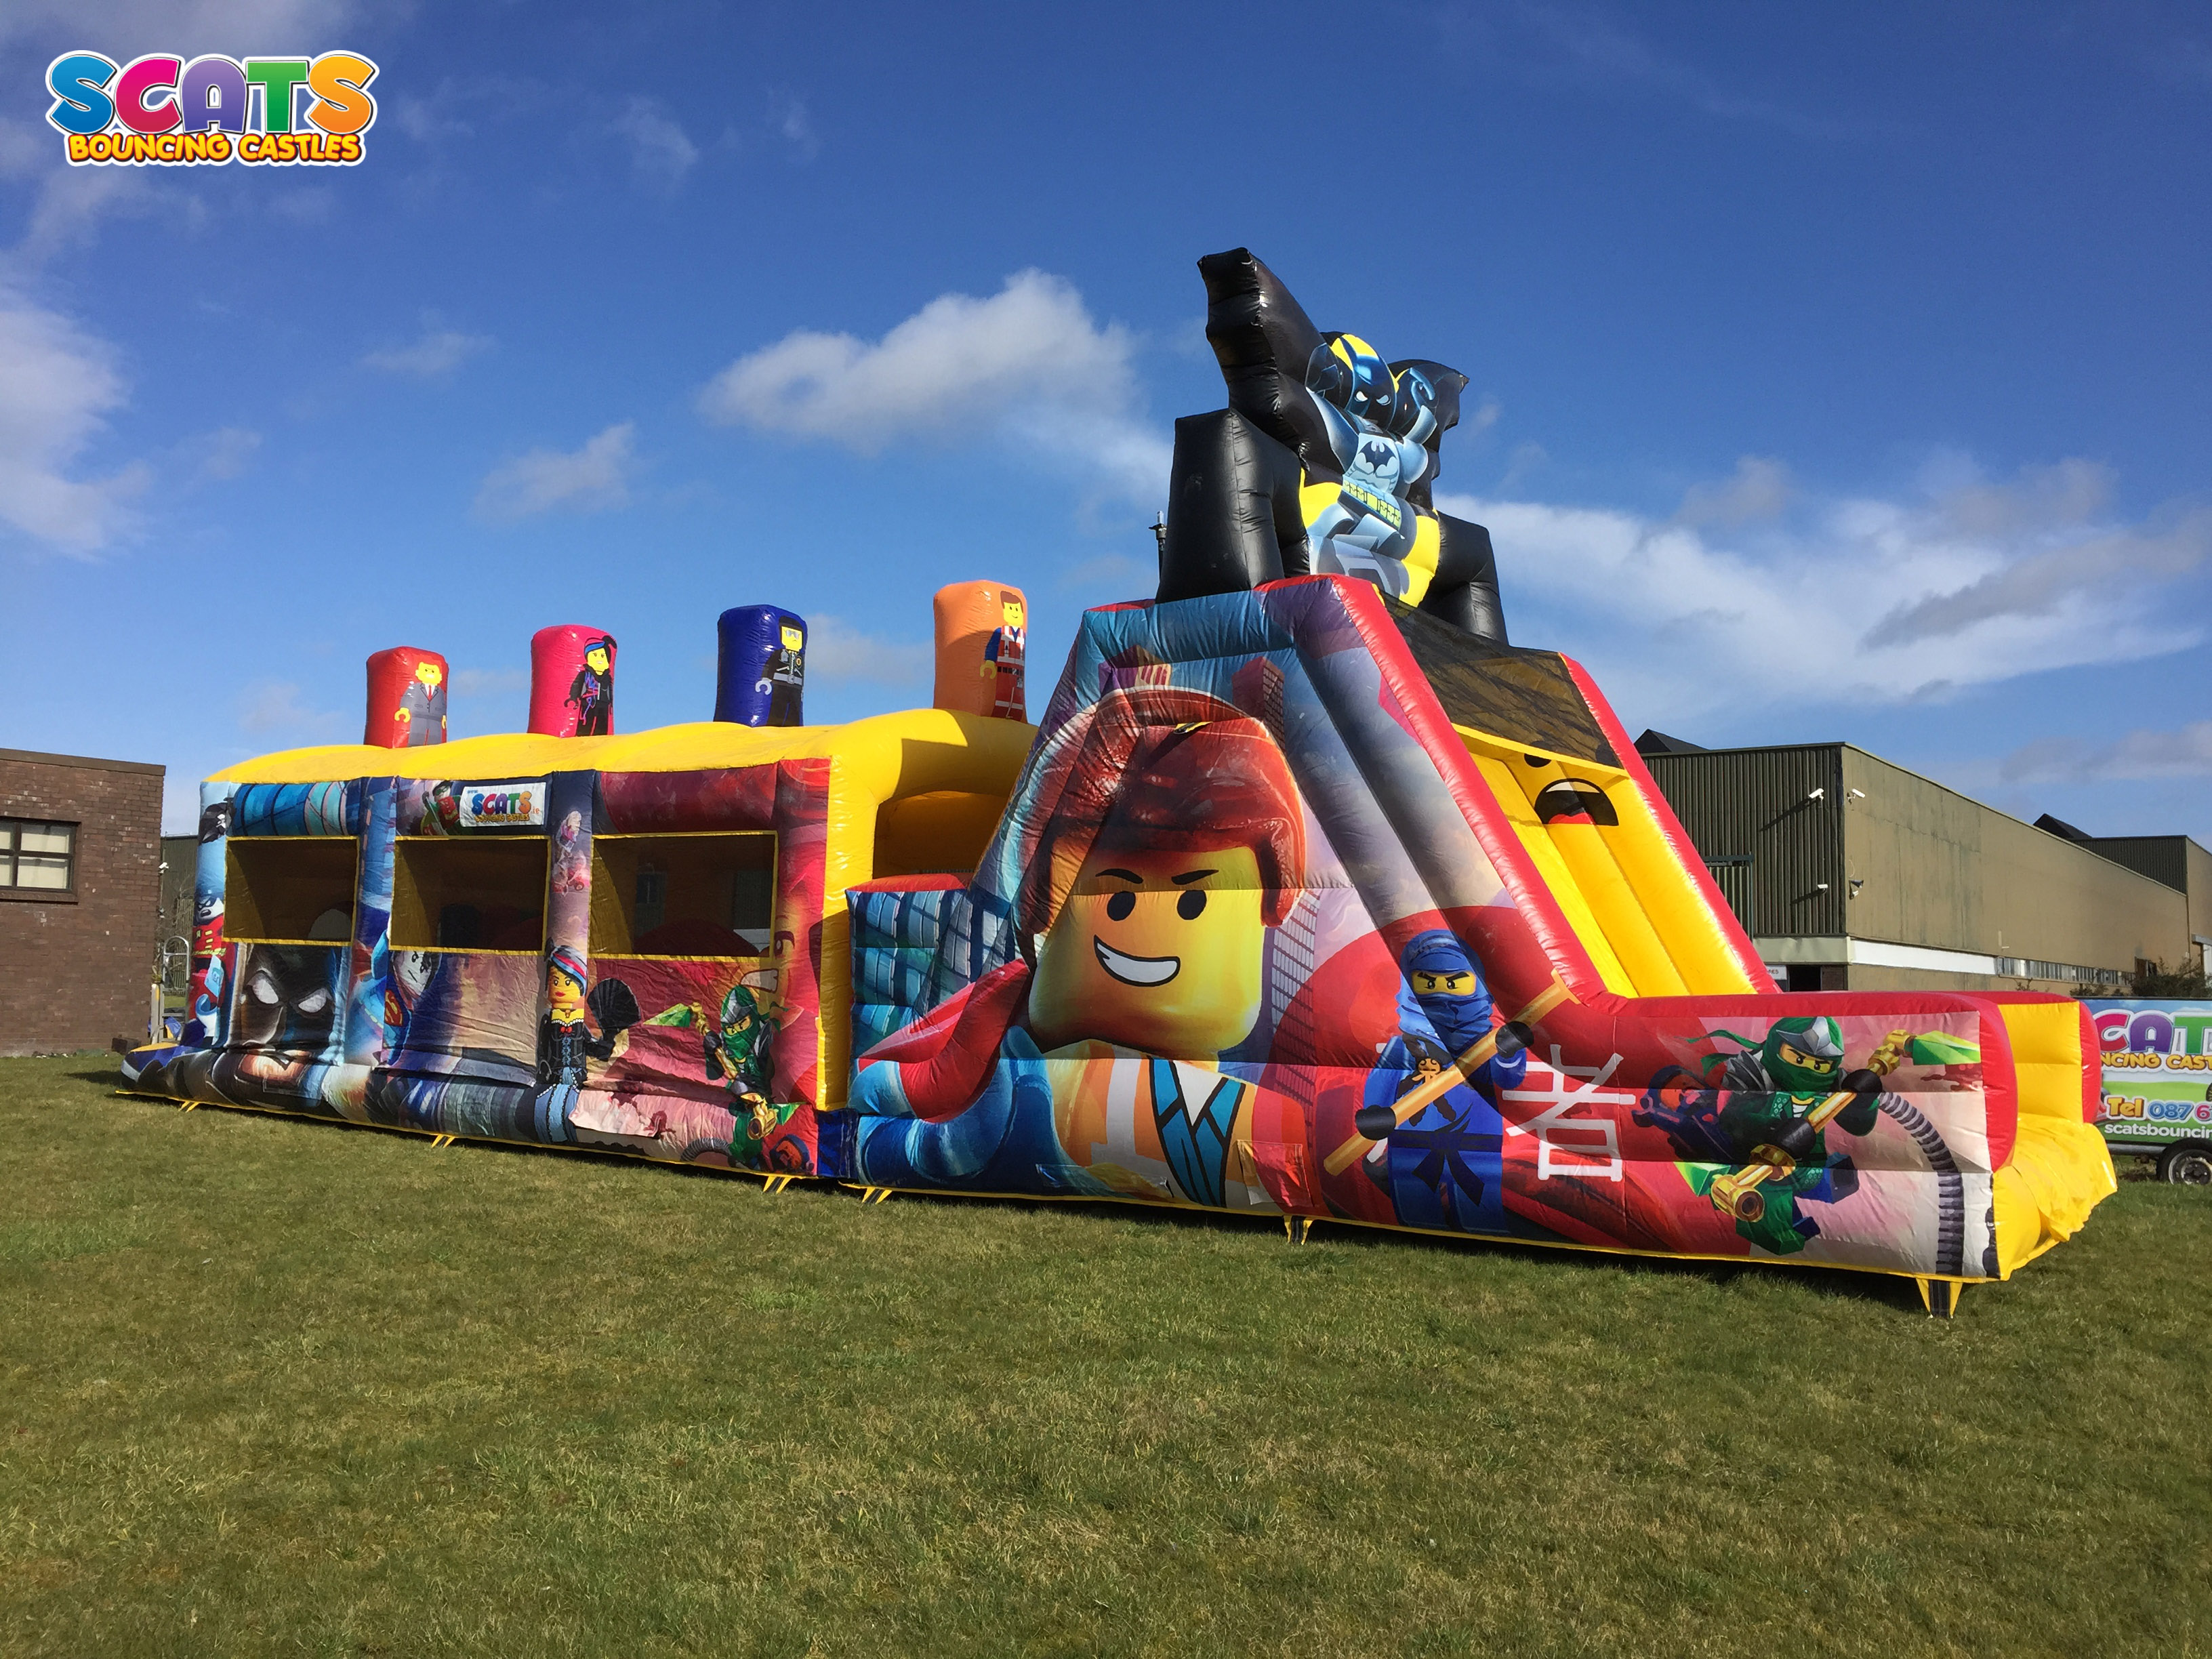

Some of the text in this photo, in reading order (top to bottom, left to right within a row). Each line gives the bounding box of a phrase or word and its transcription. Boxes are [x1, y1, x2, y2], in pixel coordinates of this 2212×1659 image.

[471, 791, 532, 815] SCATS
[2107, 1097, 2212, 1122] Tel 087 6
